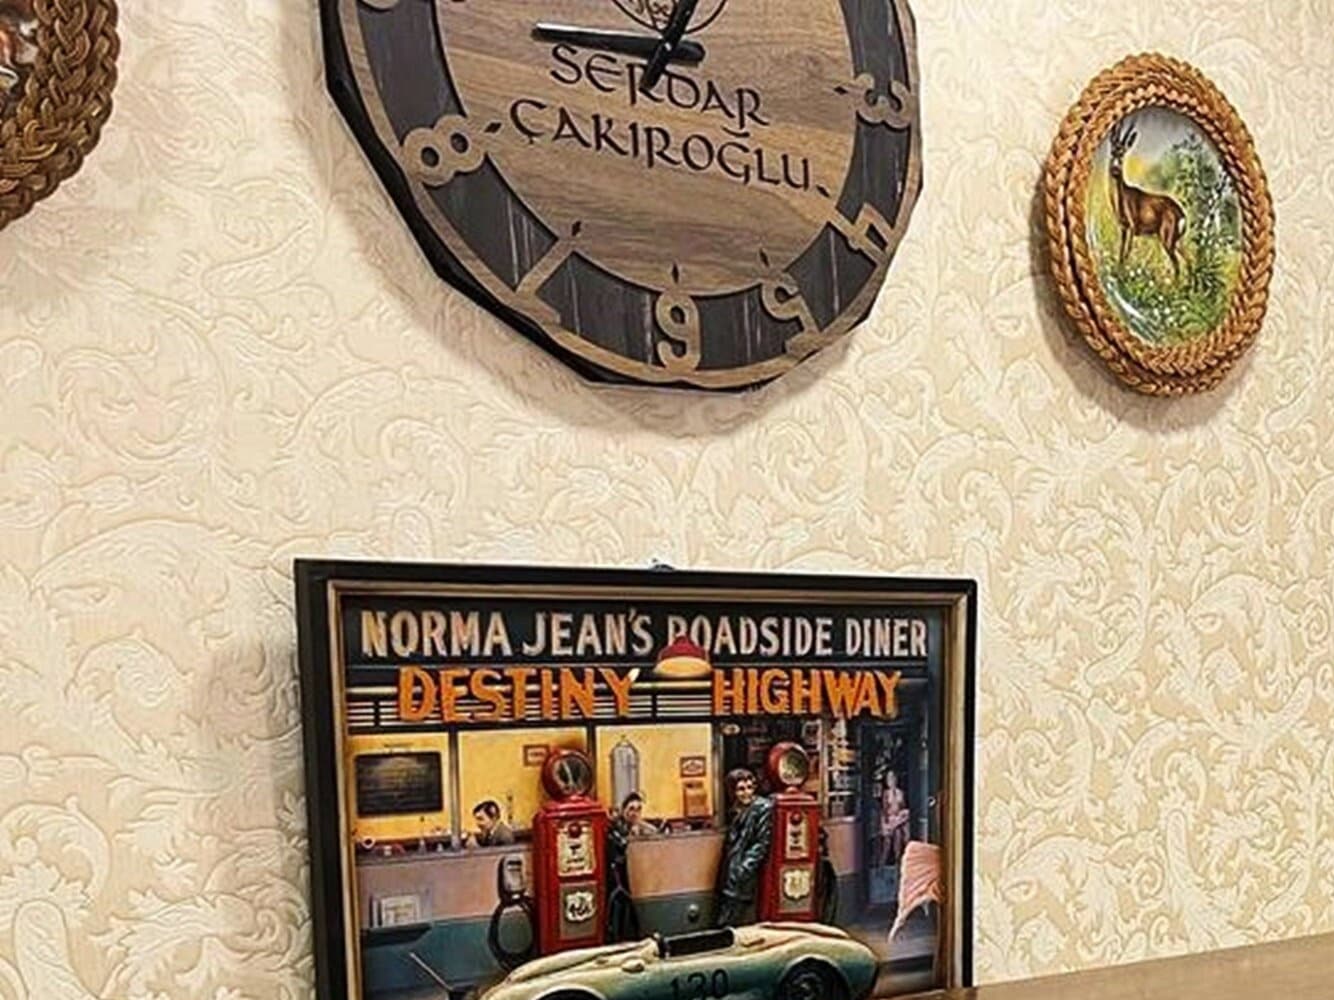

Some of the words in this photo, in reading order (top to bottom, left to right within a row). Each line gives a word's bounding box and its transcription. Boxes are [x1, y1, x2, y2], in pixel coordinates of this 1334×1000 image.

[550, 43, 770, 130] SERDAR
[401, 114, 488, 188] 8
[361, 610, 513, 658] NORMA
[522, 608, 654, 656] JEAN'S
[667, 614, 832, 657] ROADSIDE
[845, 618, 928, 657] DINER
[396, 665, 640, 723] DESTINY
[711, 667, 901, 720] HIGHWAY
